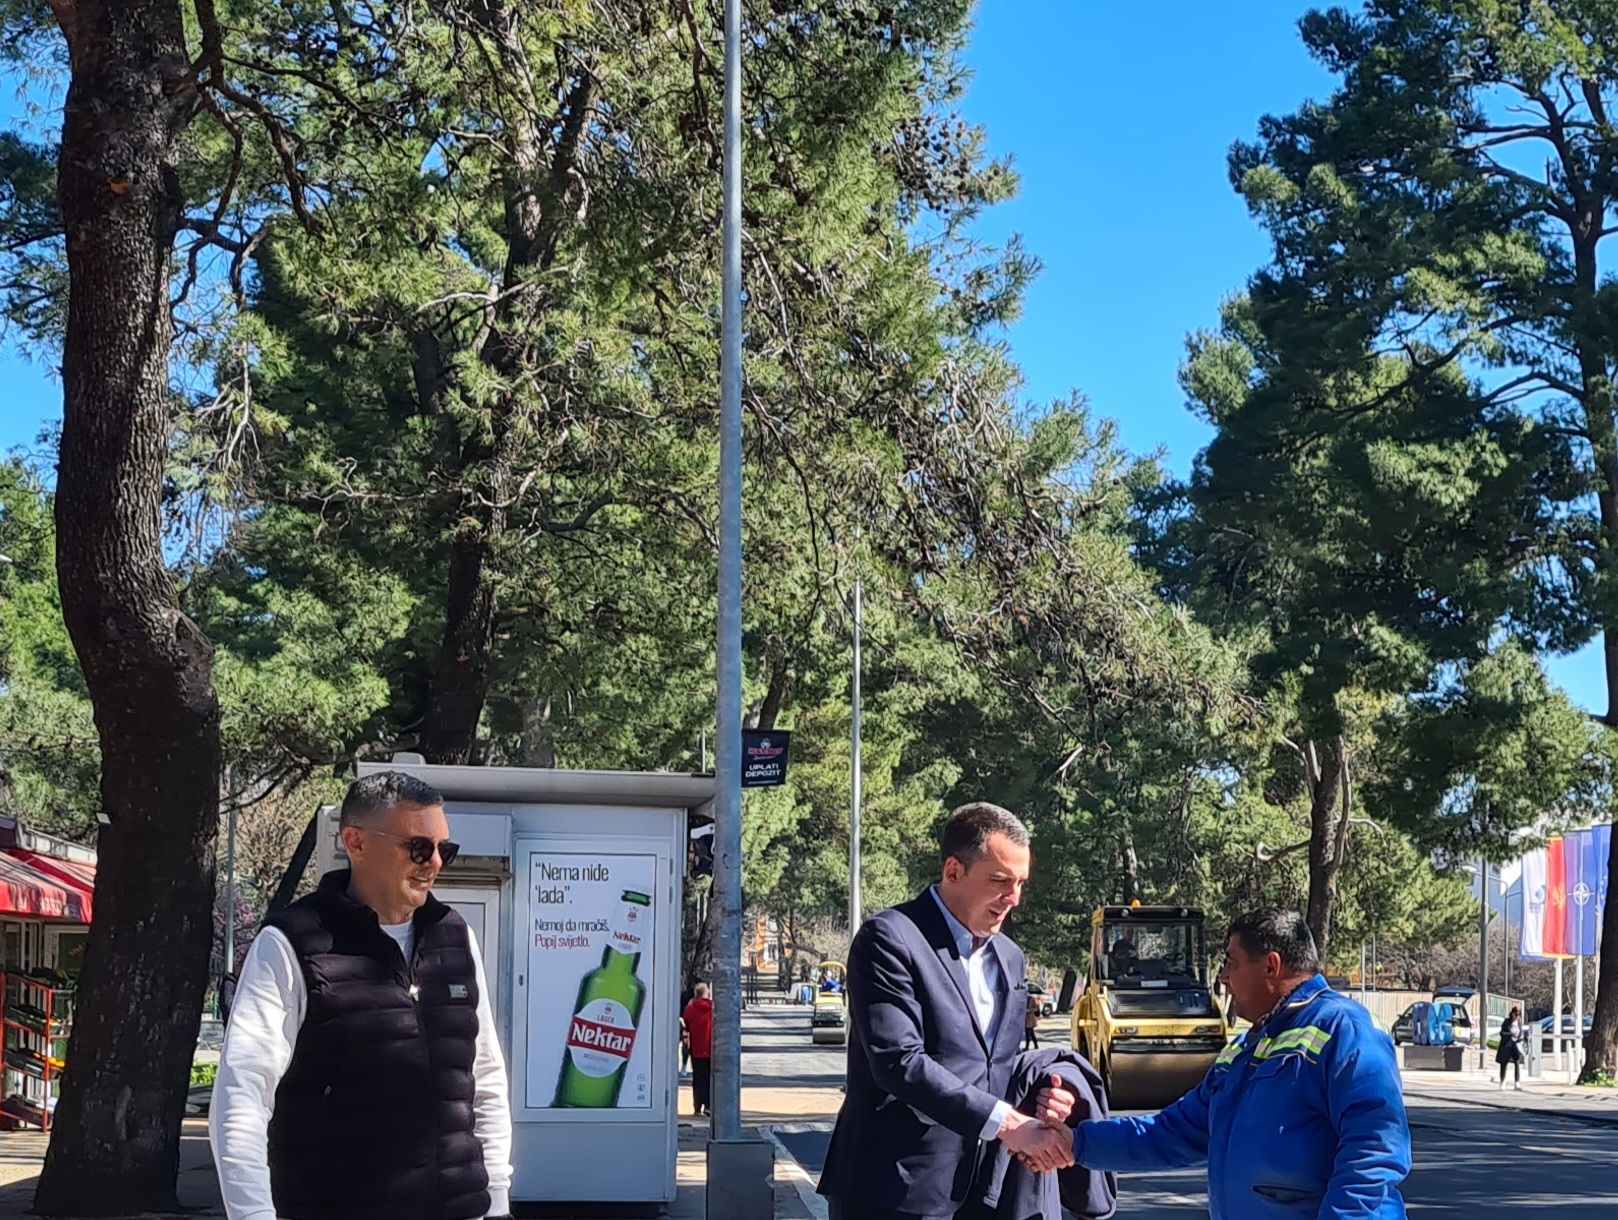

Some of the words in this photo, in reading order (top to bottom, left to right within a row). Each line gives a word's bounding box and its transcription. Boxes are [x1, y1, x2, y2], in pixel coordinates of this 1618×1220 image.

[745, 769, 781, 778] DEPOZIT
[534, 918, 564, 934] Nemoj
[565, 918, 577, 932] da
[534, 933, 557, 950] Popij
[571, 1021, 632, 1054] Nektar
